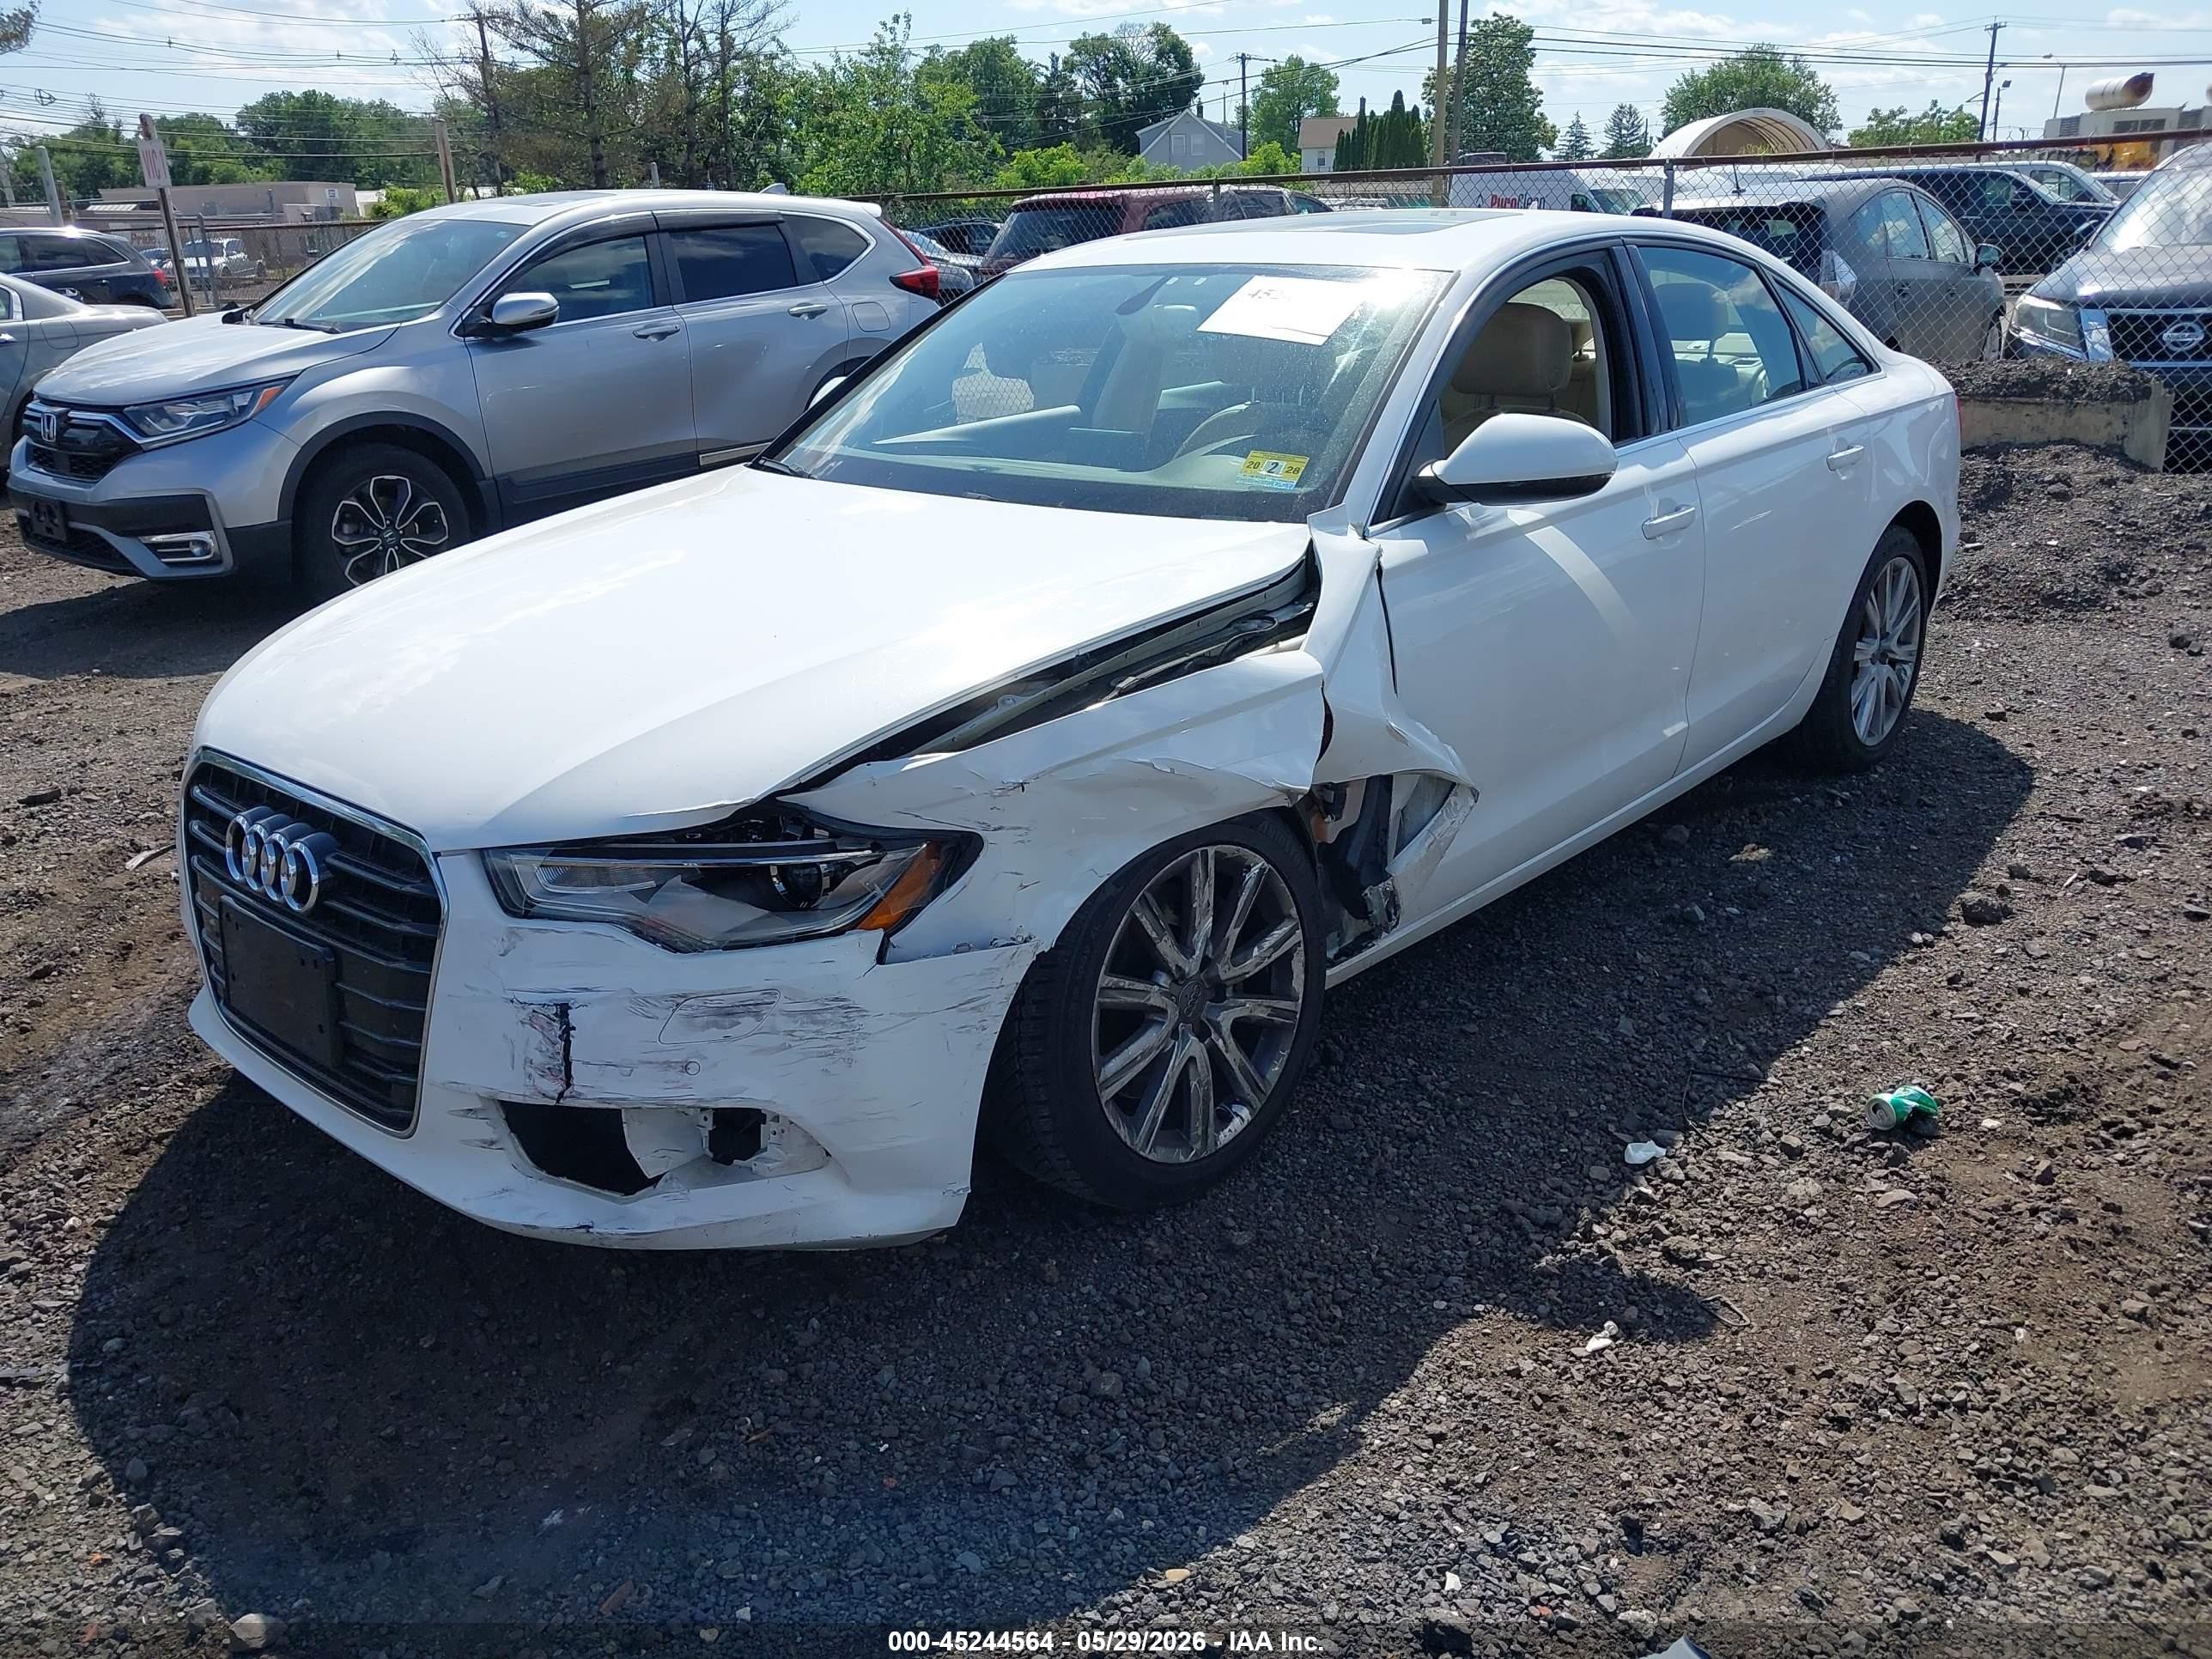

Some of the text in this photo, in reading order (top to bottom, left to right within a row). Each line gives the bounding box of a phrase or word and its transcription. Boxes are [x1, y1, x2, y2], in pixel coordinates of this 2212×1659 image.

[1246, 460, 1301, 475] 20 2 28
